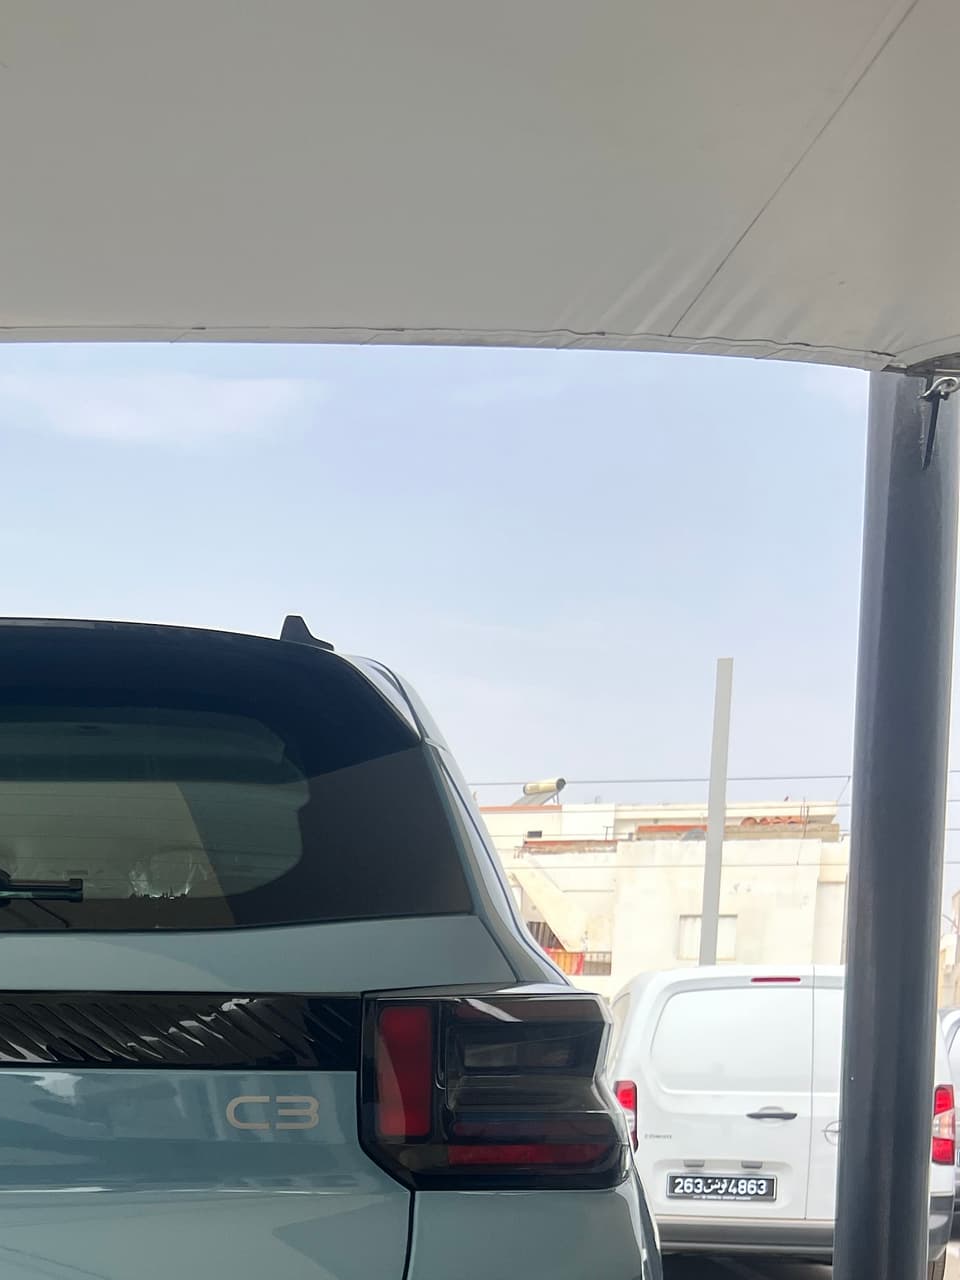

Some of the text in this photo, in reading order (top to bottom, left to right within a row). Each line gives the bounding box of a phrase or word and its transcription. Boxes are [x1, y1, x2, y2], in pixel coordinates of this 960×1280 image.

[226, 1095, 320, 1129] C3
[674, 1178, 703, 1194] 263
[728, 1179, 767, 1195] 4863
